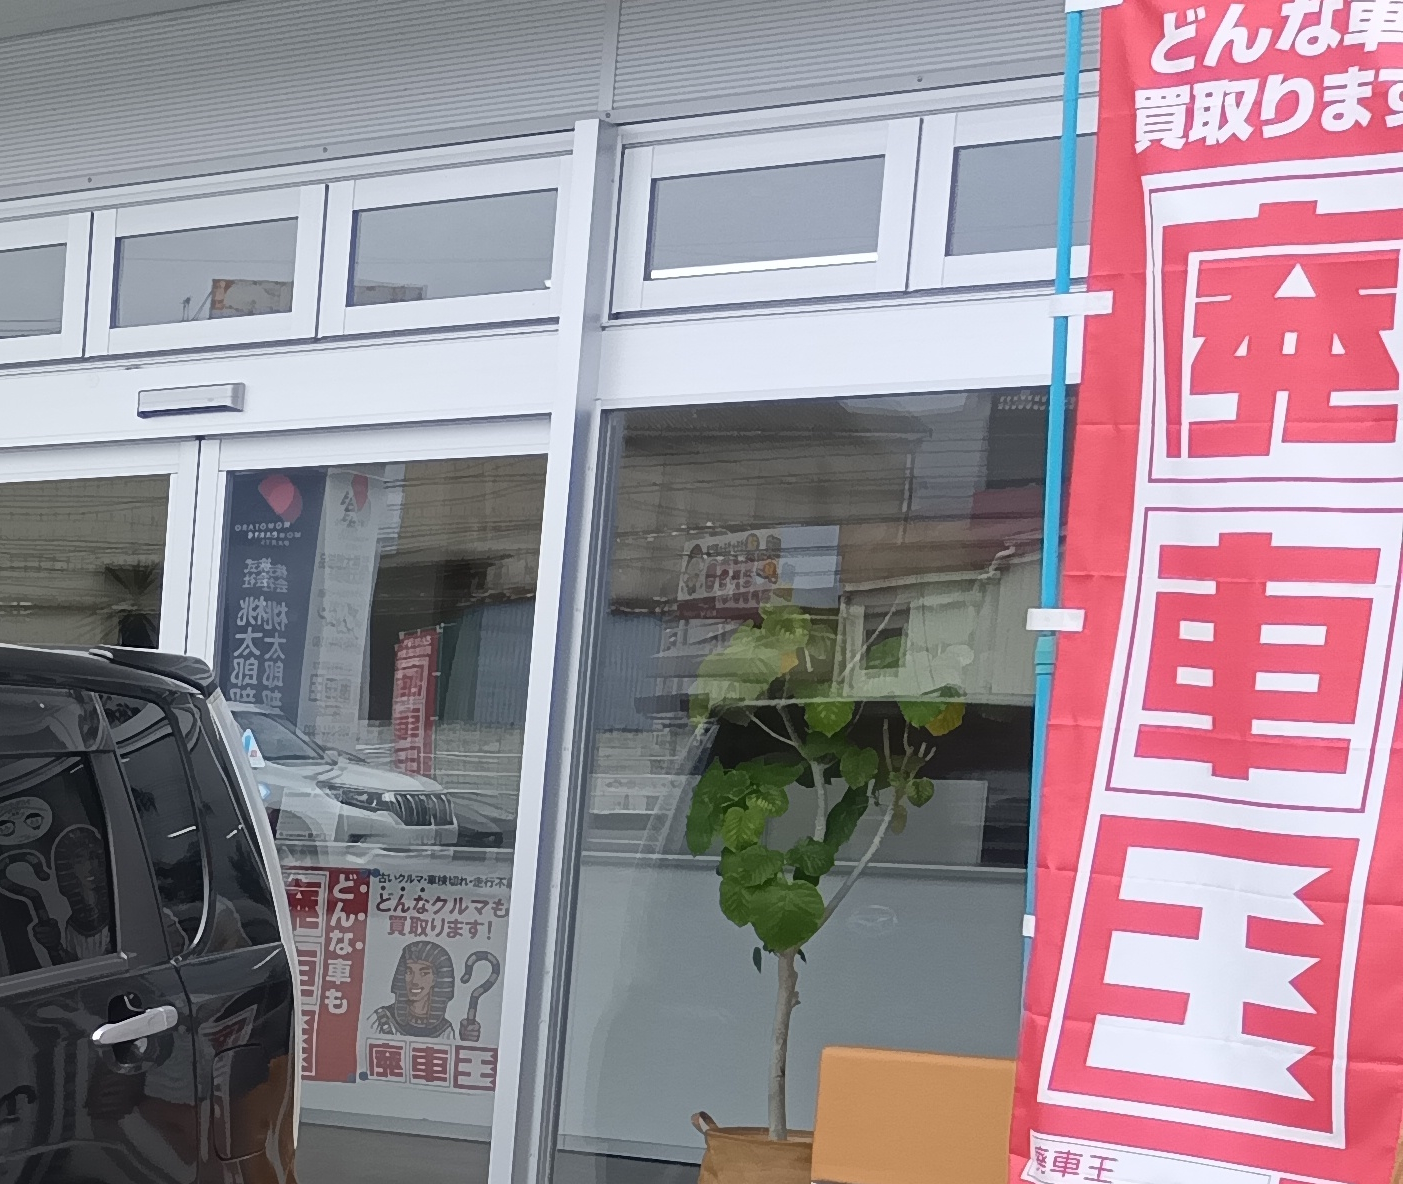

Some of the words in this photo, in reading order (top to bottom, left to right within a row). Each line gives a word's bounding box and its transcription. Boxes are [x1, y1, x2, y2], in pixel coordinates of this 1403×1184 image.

[375, 892, 509, 918] どんなクルマも
[325, 873, 357, 1014] どんな車も
[369, 1043, 497, 1092] 廃車王
